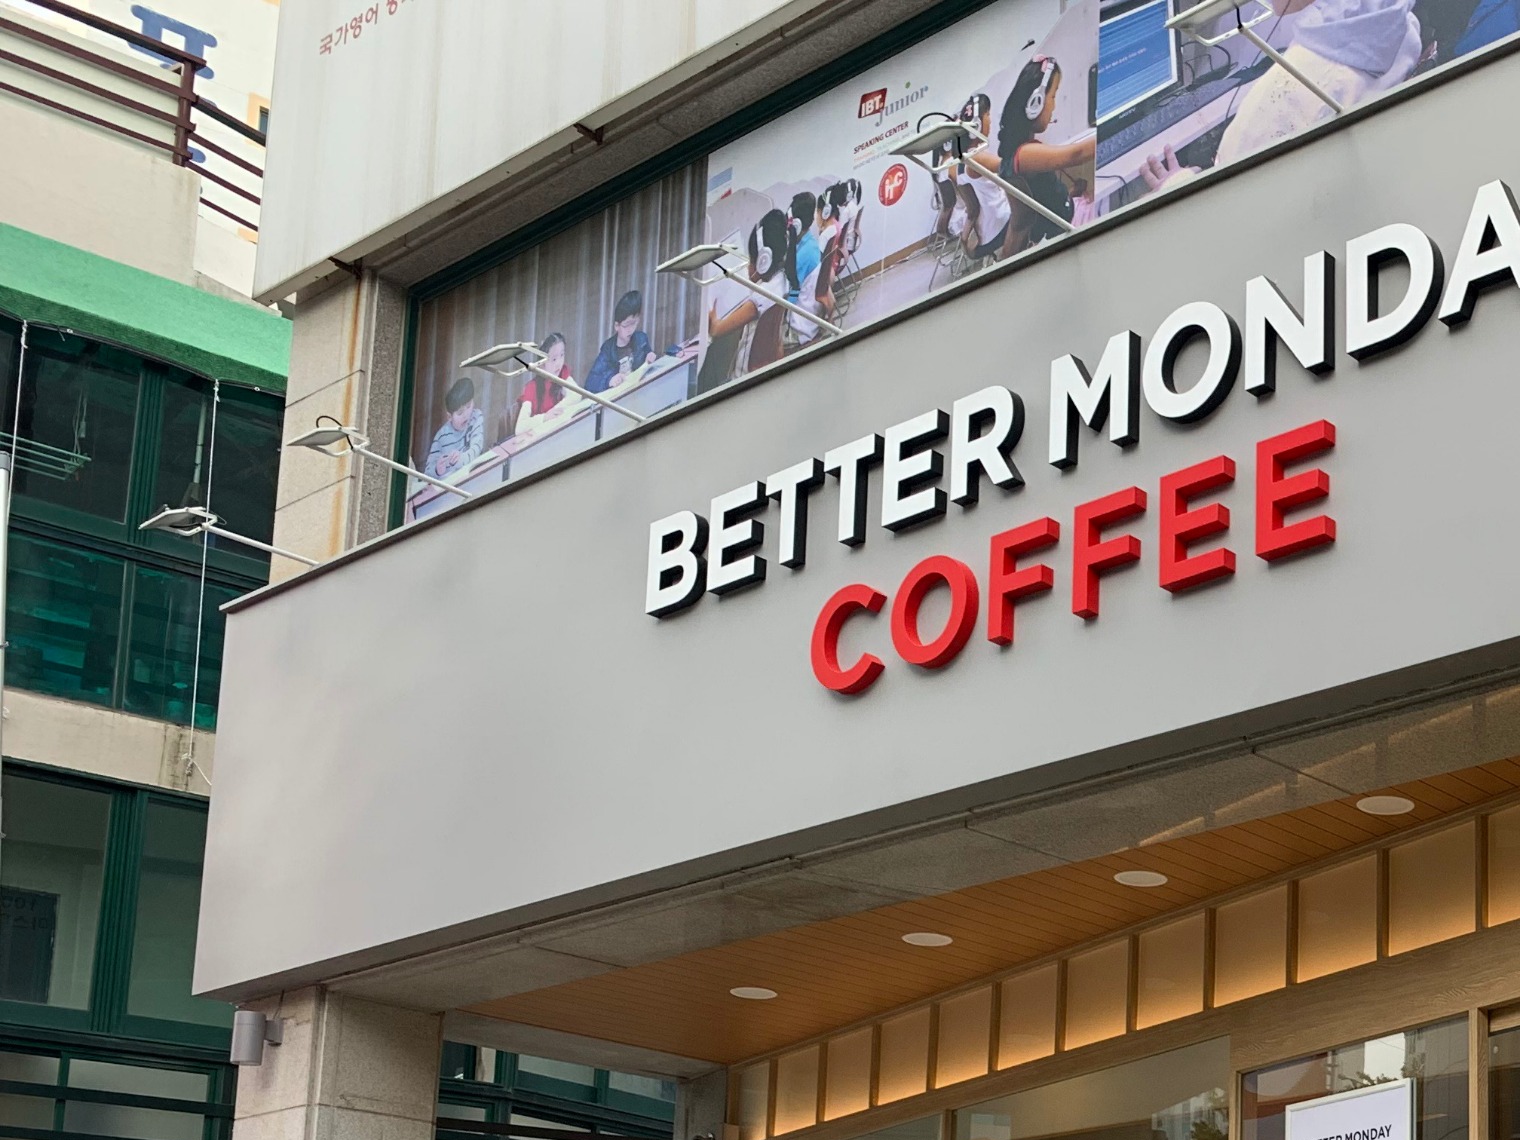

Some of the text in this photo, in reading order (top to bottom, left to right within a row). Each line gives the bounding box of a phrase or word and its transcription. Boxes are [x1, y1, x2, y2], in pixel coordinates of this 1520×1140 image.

[319, 3, 379, 55] 국가영어
[853, 121, 909, 154] SPEAKING CENTER
[645, 385, 1025, 619] BETTER
[810, 418, 1337, 695] COFFEE
